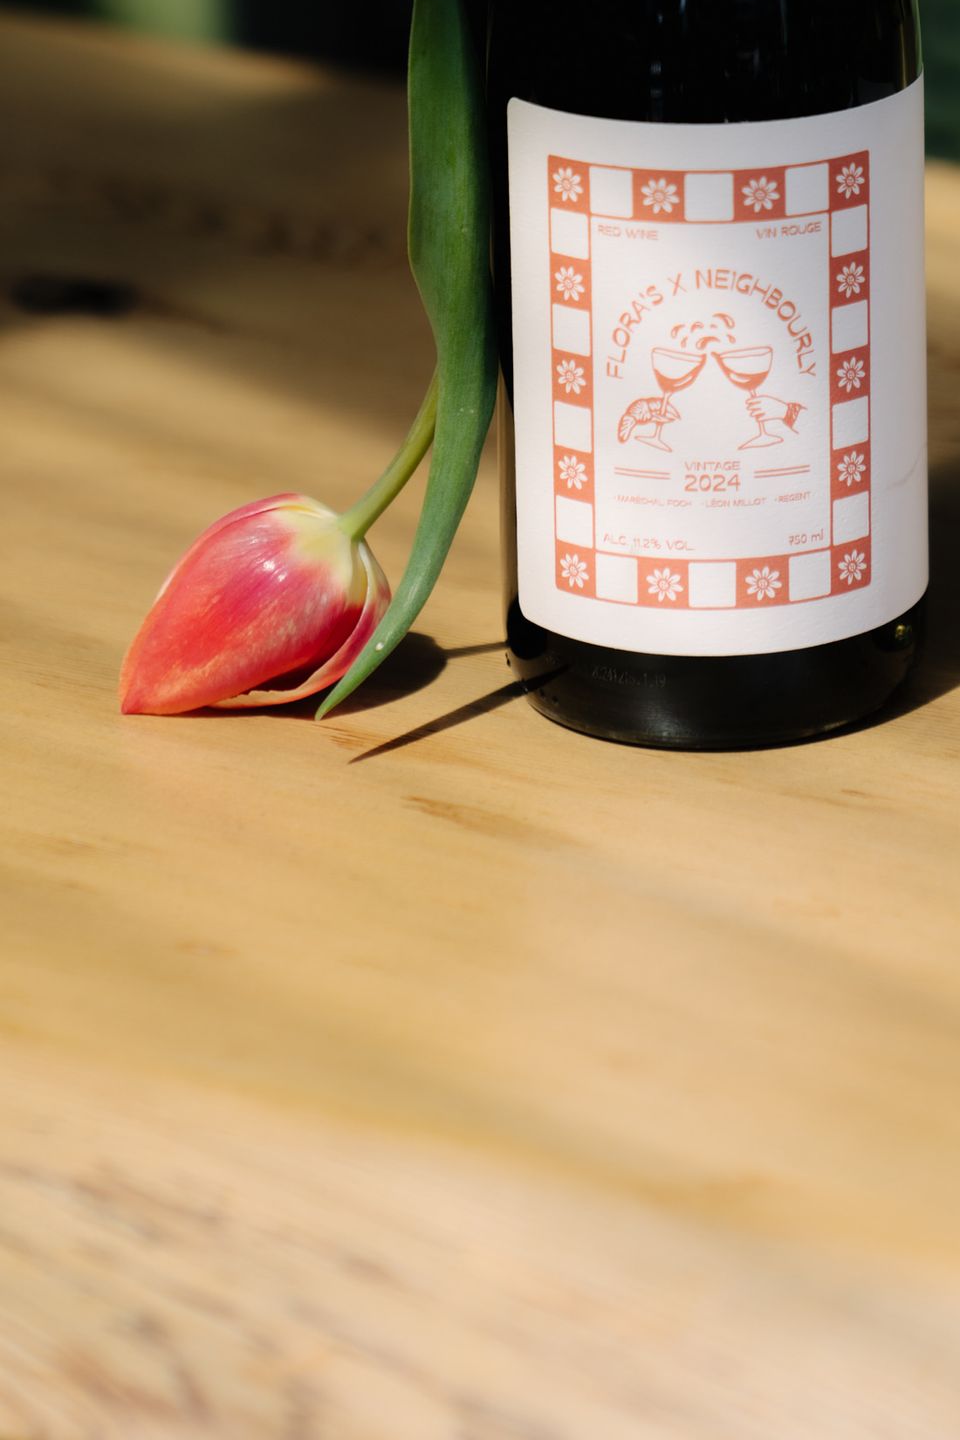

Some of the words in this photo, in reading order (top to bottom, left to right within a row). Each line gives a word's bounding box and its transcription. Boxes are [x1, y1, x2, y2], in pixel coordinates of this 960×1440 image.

[597, 224, 622, 238] RED
[625, 227, 659, 240] WINE
[756, 227, 777, 240] VIN
[782, 221, 822, 236] ROUGE
[606, 284, 664, 379] FLORA'S
[667, 273, 687, 296] X
[695, 268, 817, 378] NEIGHBOURLY
[684, 460, 741, 471] VINTAGE
[684, 474, 741, 492] 2024
[788, 534, 807, 546] 750
[811, 528, 824, 541] ml
